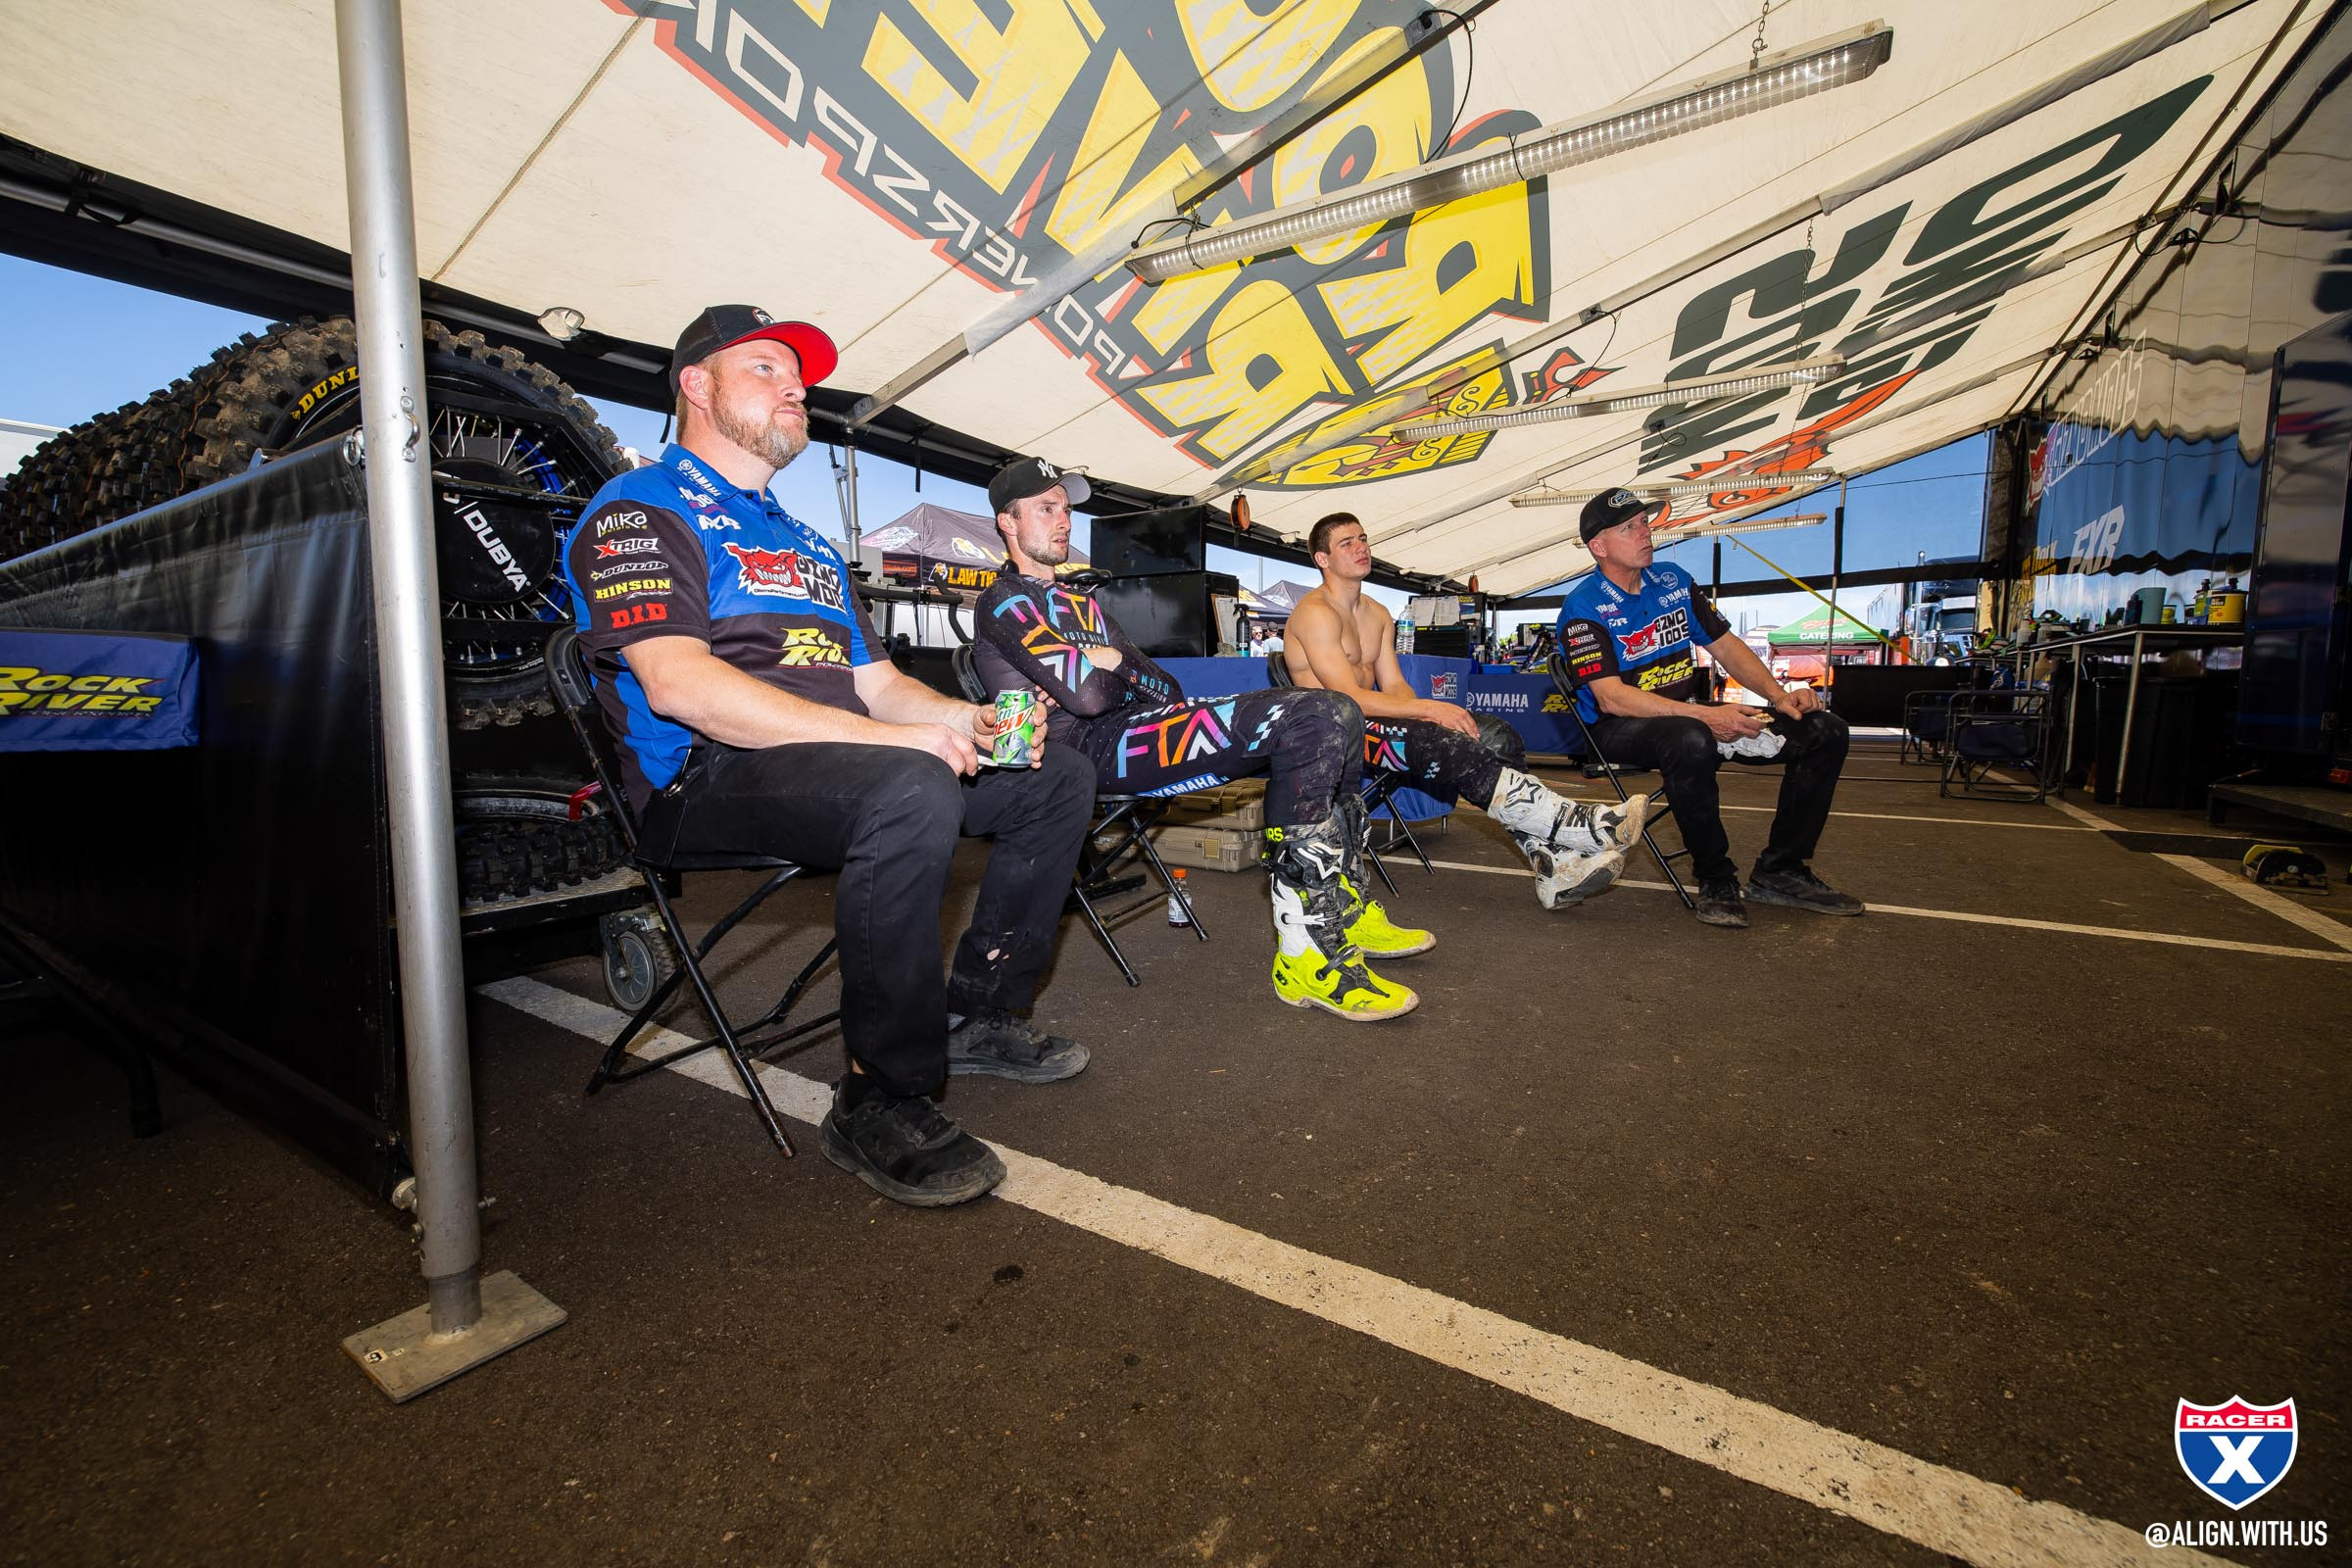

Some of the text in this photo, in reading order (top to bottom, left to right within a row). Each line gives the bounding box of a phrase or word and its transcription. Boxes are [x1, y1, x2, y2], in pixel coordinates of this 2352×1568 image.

[298, 366, 361, 415] DUNL
[688, 466, 722, 497] YAMAHA
[463, 509, 530, 593] DUBYA
[592, 539, 656, 560] XTRIG
[2068, 505, 2125, 575] FXR
[948, 566, 998, 588] LAW TIG
[595, 578, 671, 600] HINSON
[611, 603, 668, 628] D.I.D
[1799, 631, 1854, 640] CATEING
[1638, 658, 1690, 686] ROCK
[1141, 674, 1169, 695] MOTO
[1476, 693, 1529, 708] YAMAHA
